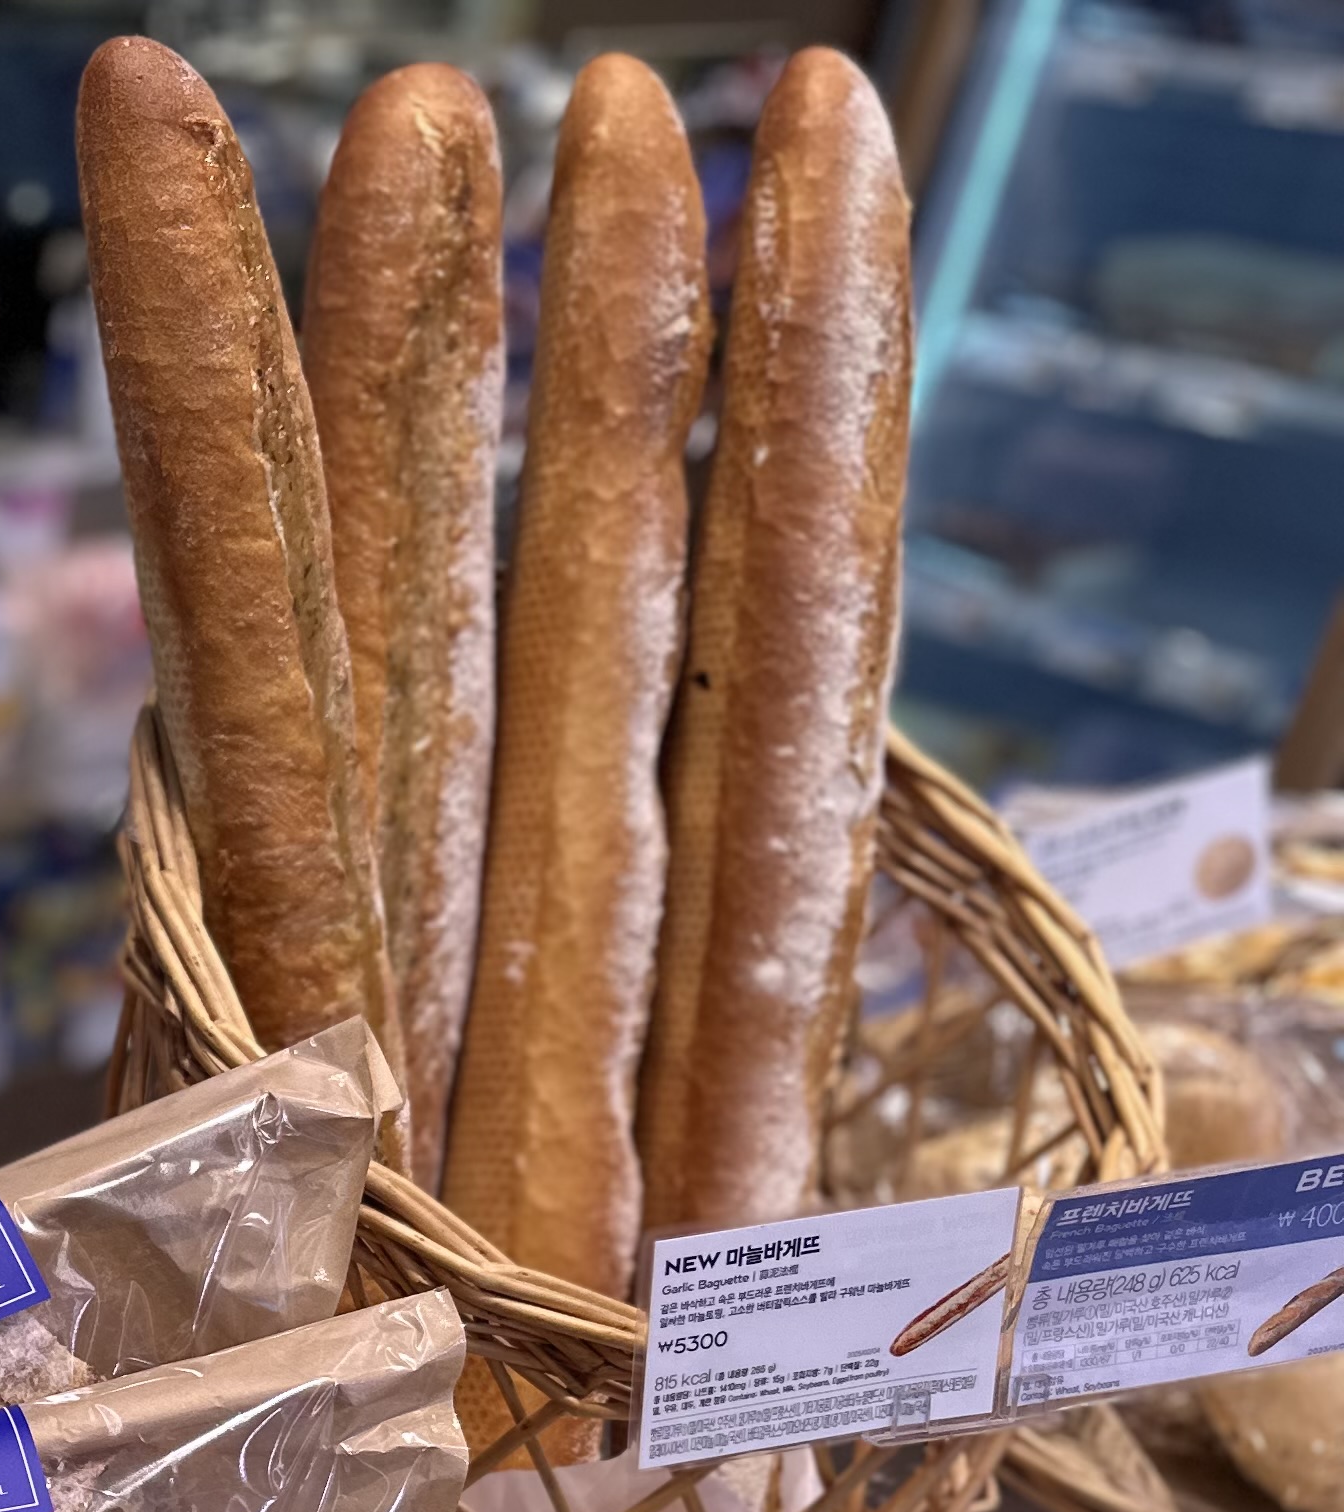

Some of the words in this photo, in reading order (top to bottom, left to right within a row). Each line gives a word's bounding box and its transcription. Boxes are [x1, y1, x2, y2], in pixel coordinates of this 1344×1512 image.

[1056, 1190, 1194, 1226] 프렌치바게뜨
[663, 1251, 721, 1276] NEW
[726, 1234, 822, 1268] 마늘바게뜨
[661, 1280, 695, 1296] Garlic
[697, 1272, 750, 1292] Baguette
[1029, 1284, 1053, 1312] 총
[1057, 1273, 1147, 1304] 내용량(248
[1147, 1269, 1166, 1294] g)
[1169, 1265, 1201, 1286] 625
[1204, 1259, 1240, 1284] kcal
[657, 1329, 728, 1357] ₩5300
[654, 1373, 679, 1392] 815
[680, 1368, 711, 1387] kcal
